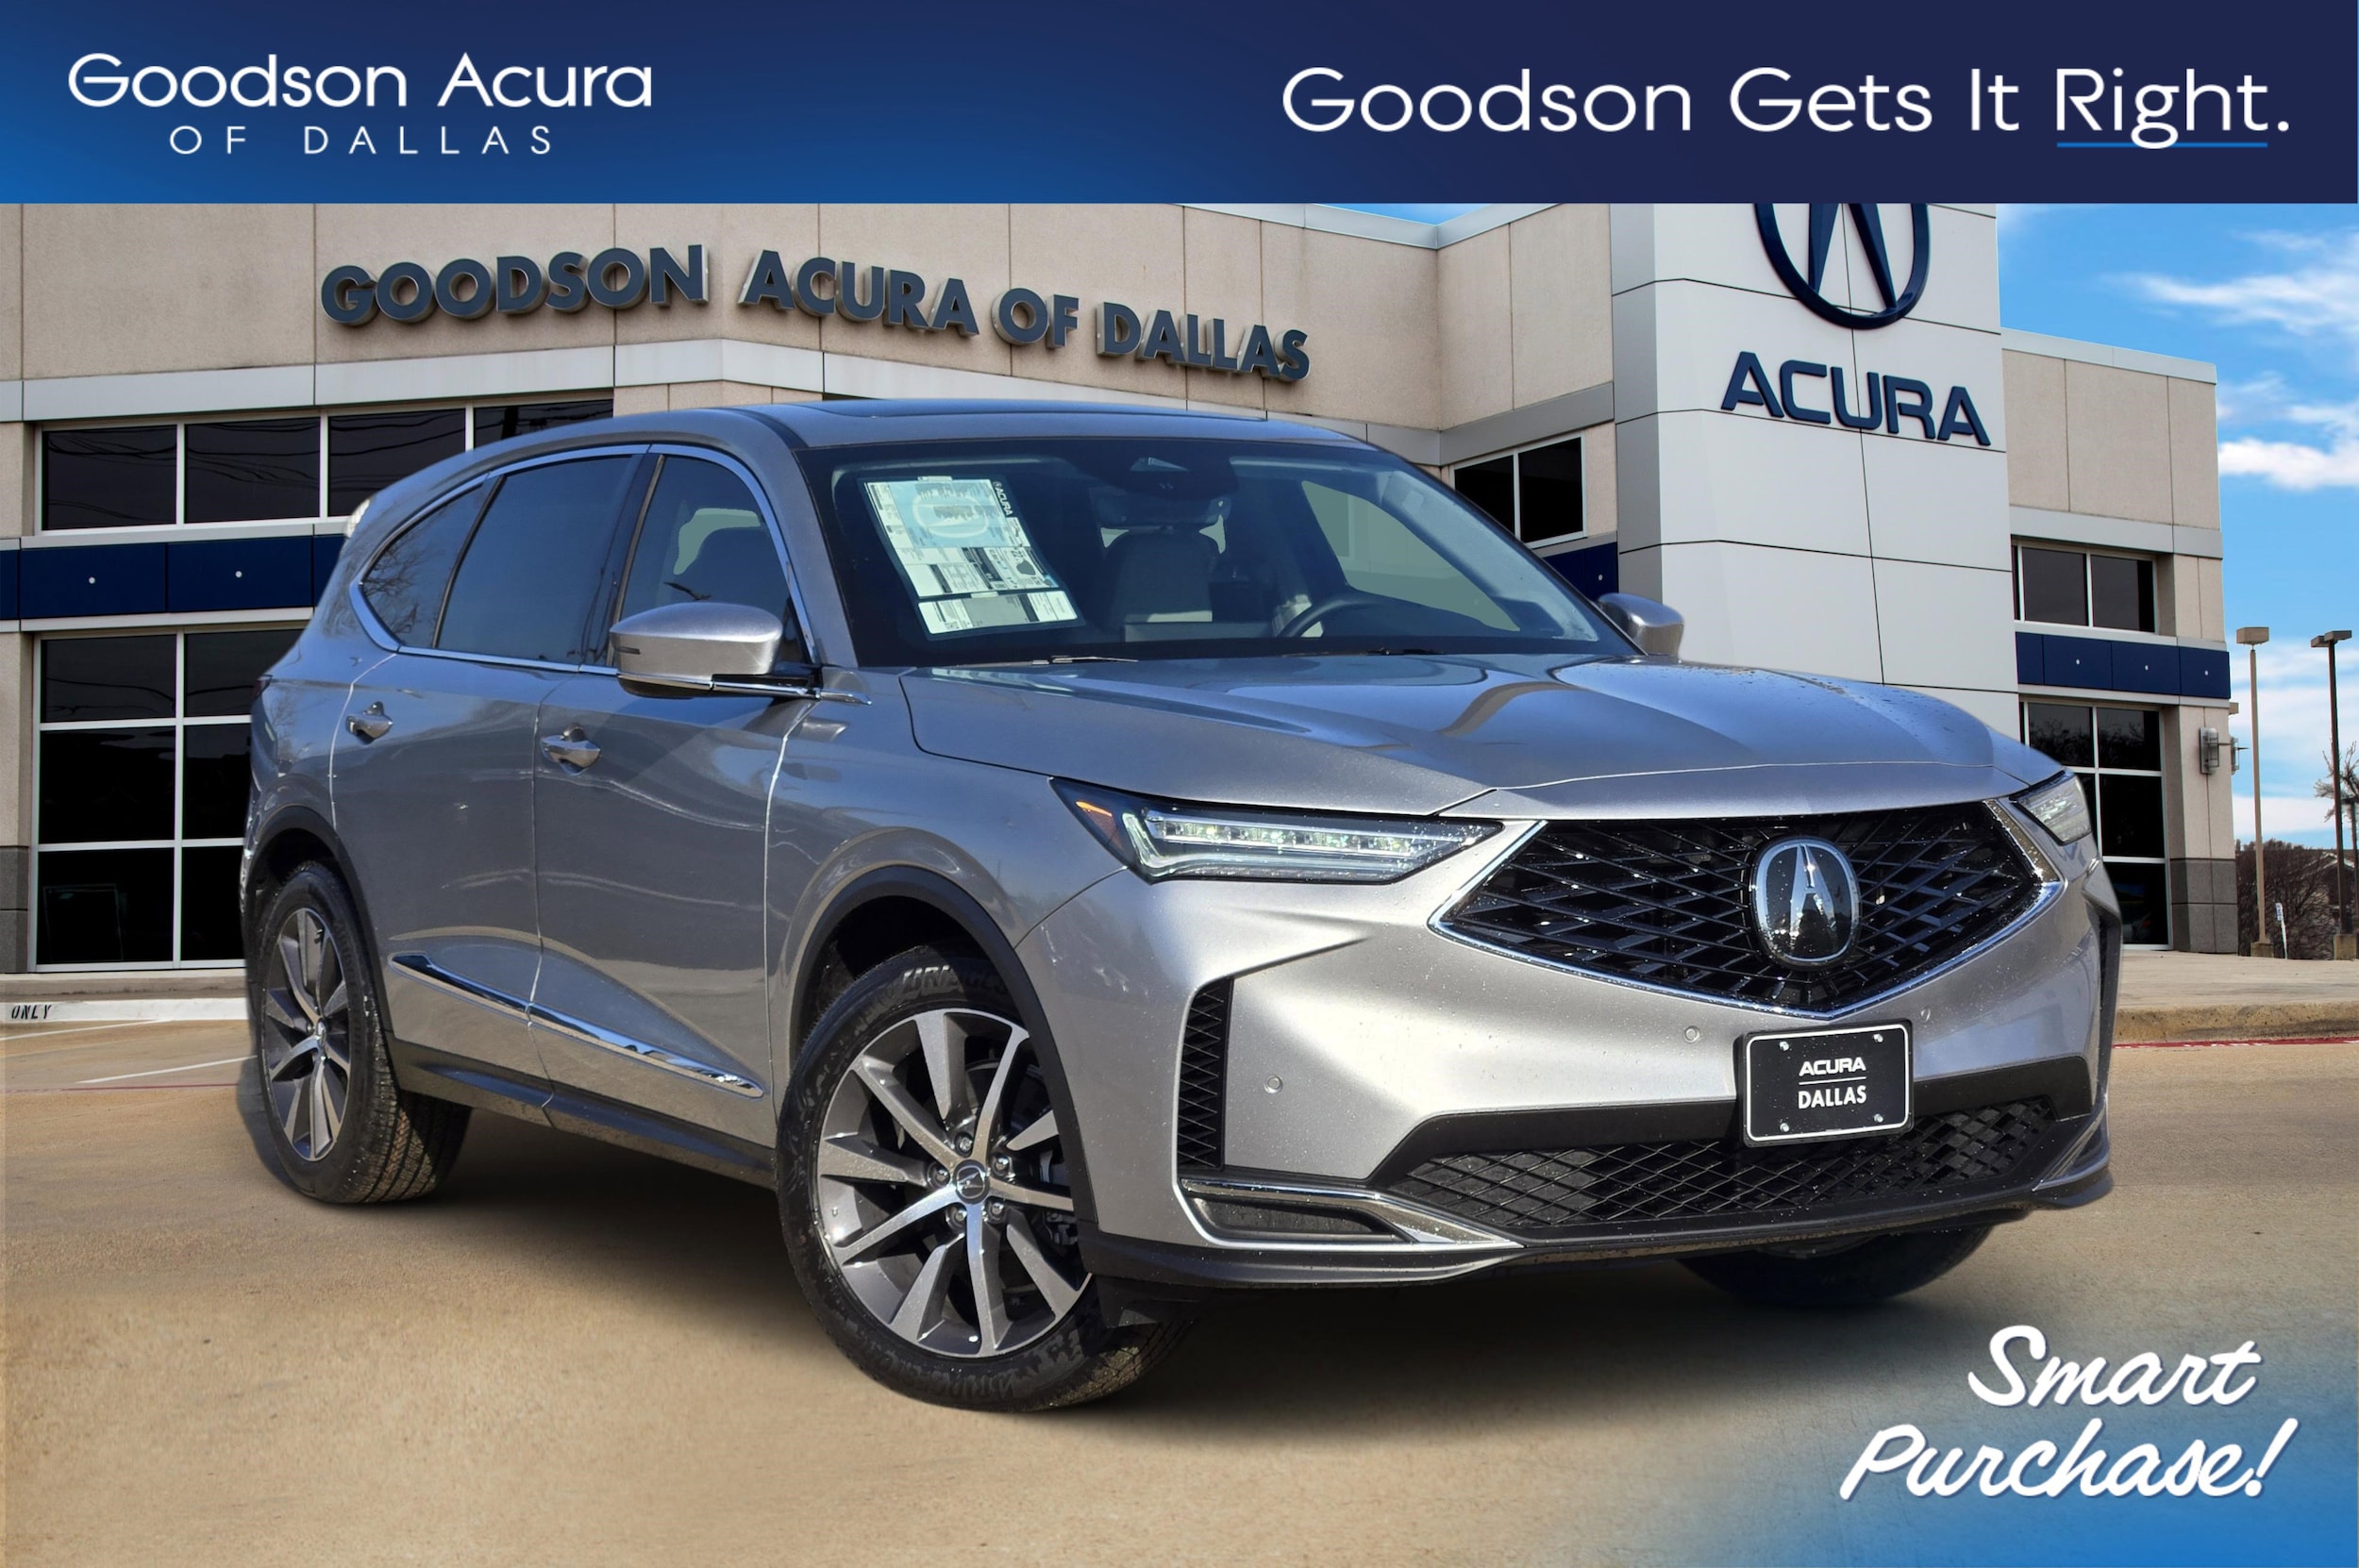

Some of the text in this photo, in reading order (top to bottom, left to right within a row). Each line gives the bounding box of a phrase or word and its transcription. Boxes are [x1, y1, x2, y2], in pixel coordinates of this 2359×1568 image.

[321, 244, 1311, 383] GOODSON ACURA OF DALLAS
[1720, 351, 1992, 447] ACURA
[995, 488, 1013, 515] ACURA
[11, 1004, 52, 1020] ONLY
[1799, 1057, 1866, 1076] ACURA
[1798, 1085, 1867, 1109] DALLAS
